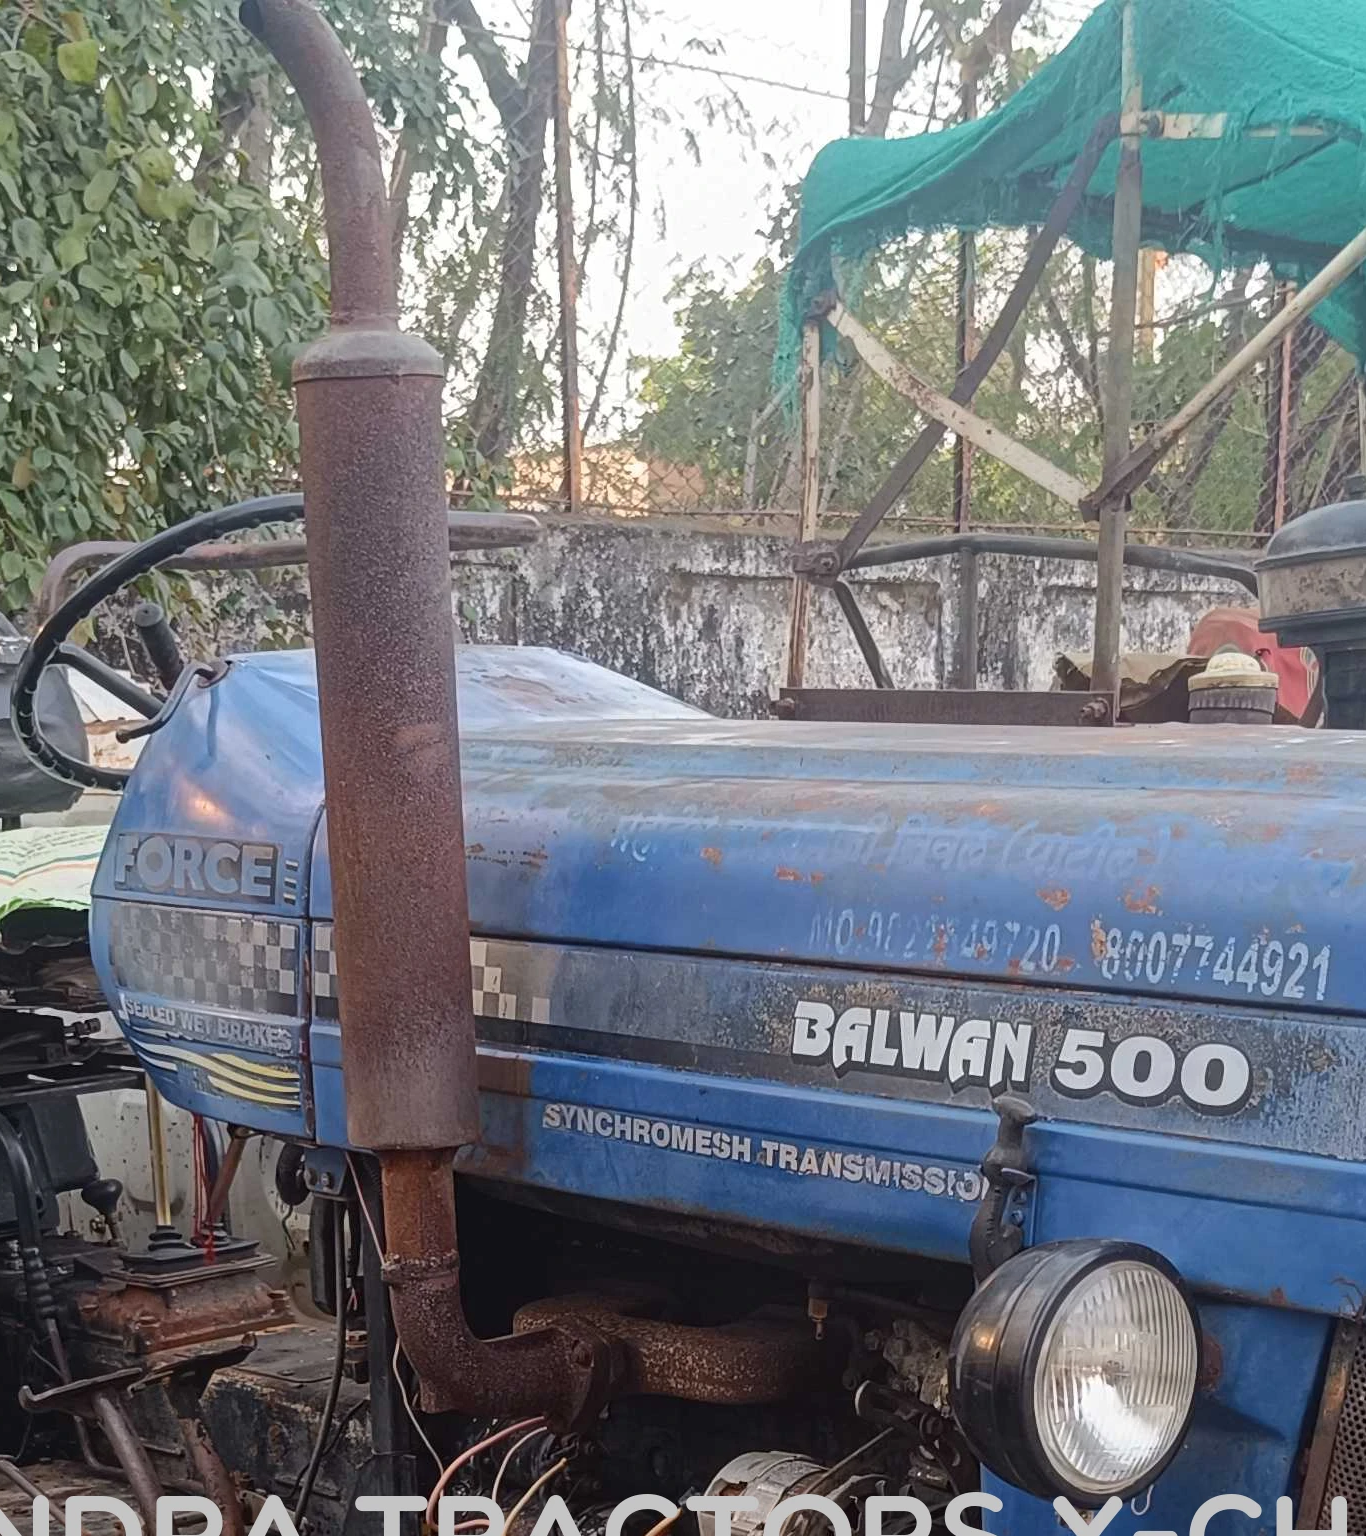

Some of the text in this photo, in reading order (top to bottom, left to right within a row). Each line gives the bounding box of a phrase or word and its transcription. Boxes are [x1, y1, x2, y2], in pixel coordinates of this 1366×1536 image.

[115, 834, 276, 898] FORCE
[125, 999, 293, 1051] SEALED WET BRAKES
[791, 1000, 1250, 1108] BALWAN 500
[542, 1103, 990, 1202] SYNCHROMESH TRANSMISSIO
